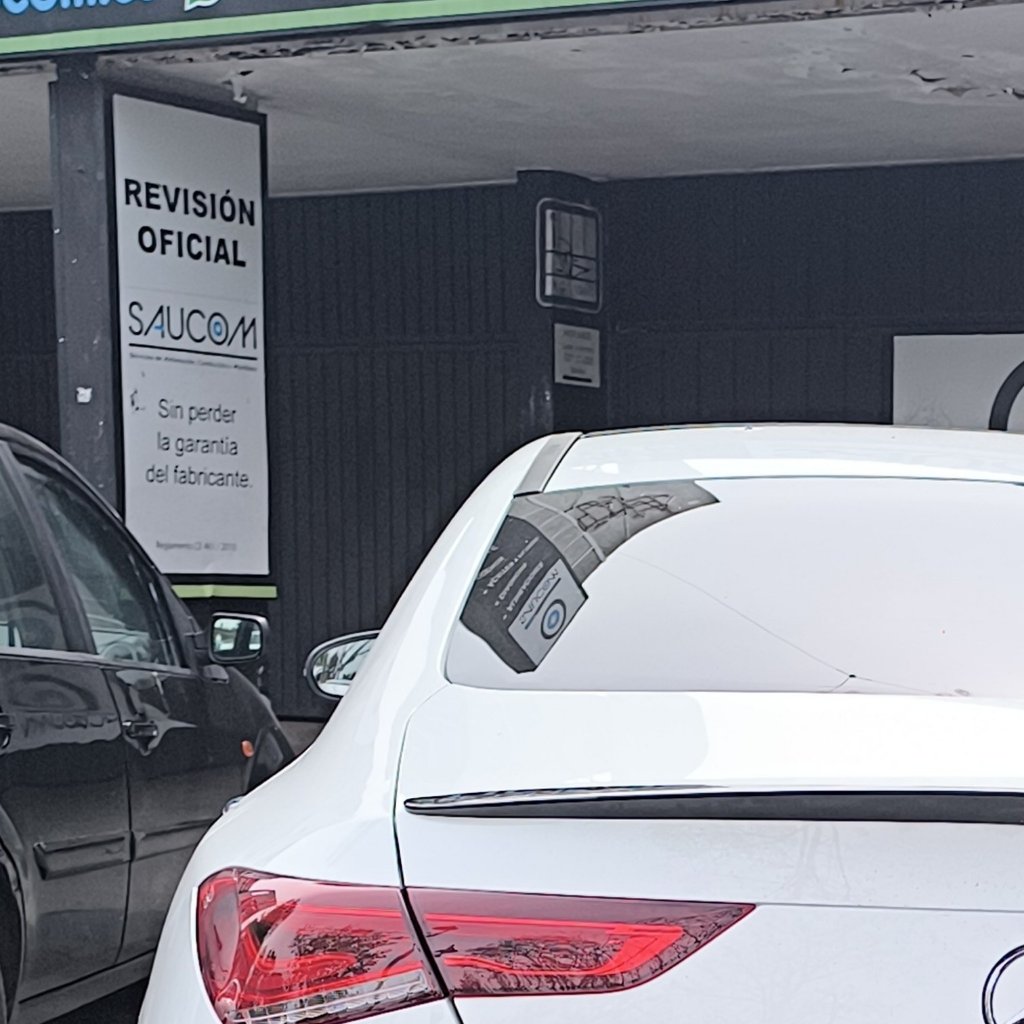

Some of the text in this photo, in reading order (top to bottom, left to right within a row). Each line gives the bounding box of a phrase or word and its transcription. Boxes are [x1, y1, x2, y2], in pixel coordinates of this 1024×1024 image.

[124, 178, 255, 226] REVISIÓN
[138, 226, 247, 267] OFICIAL
[128, 301, 257, 349] SAUCOM
[158, 398, 236, 425] Sin perder
[157, 431, 170, 451] la
[146, 464, 168, 483] del
